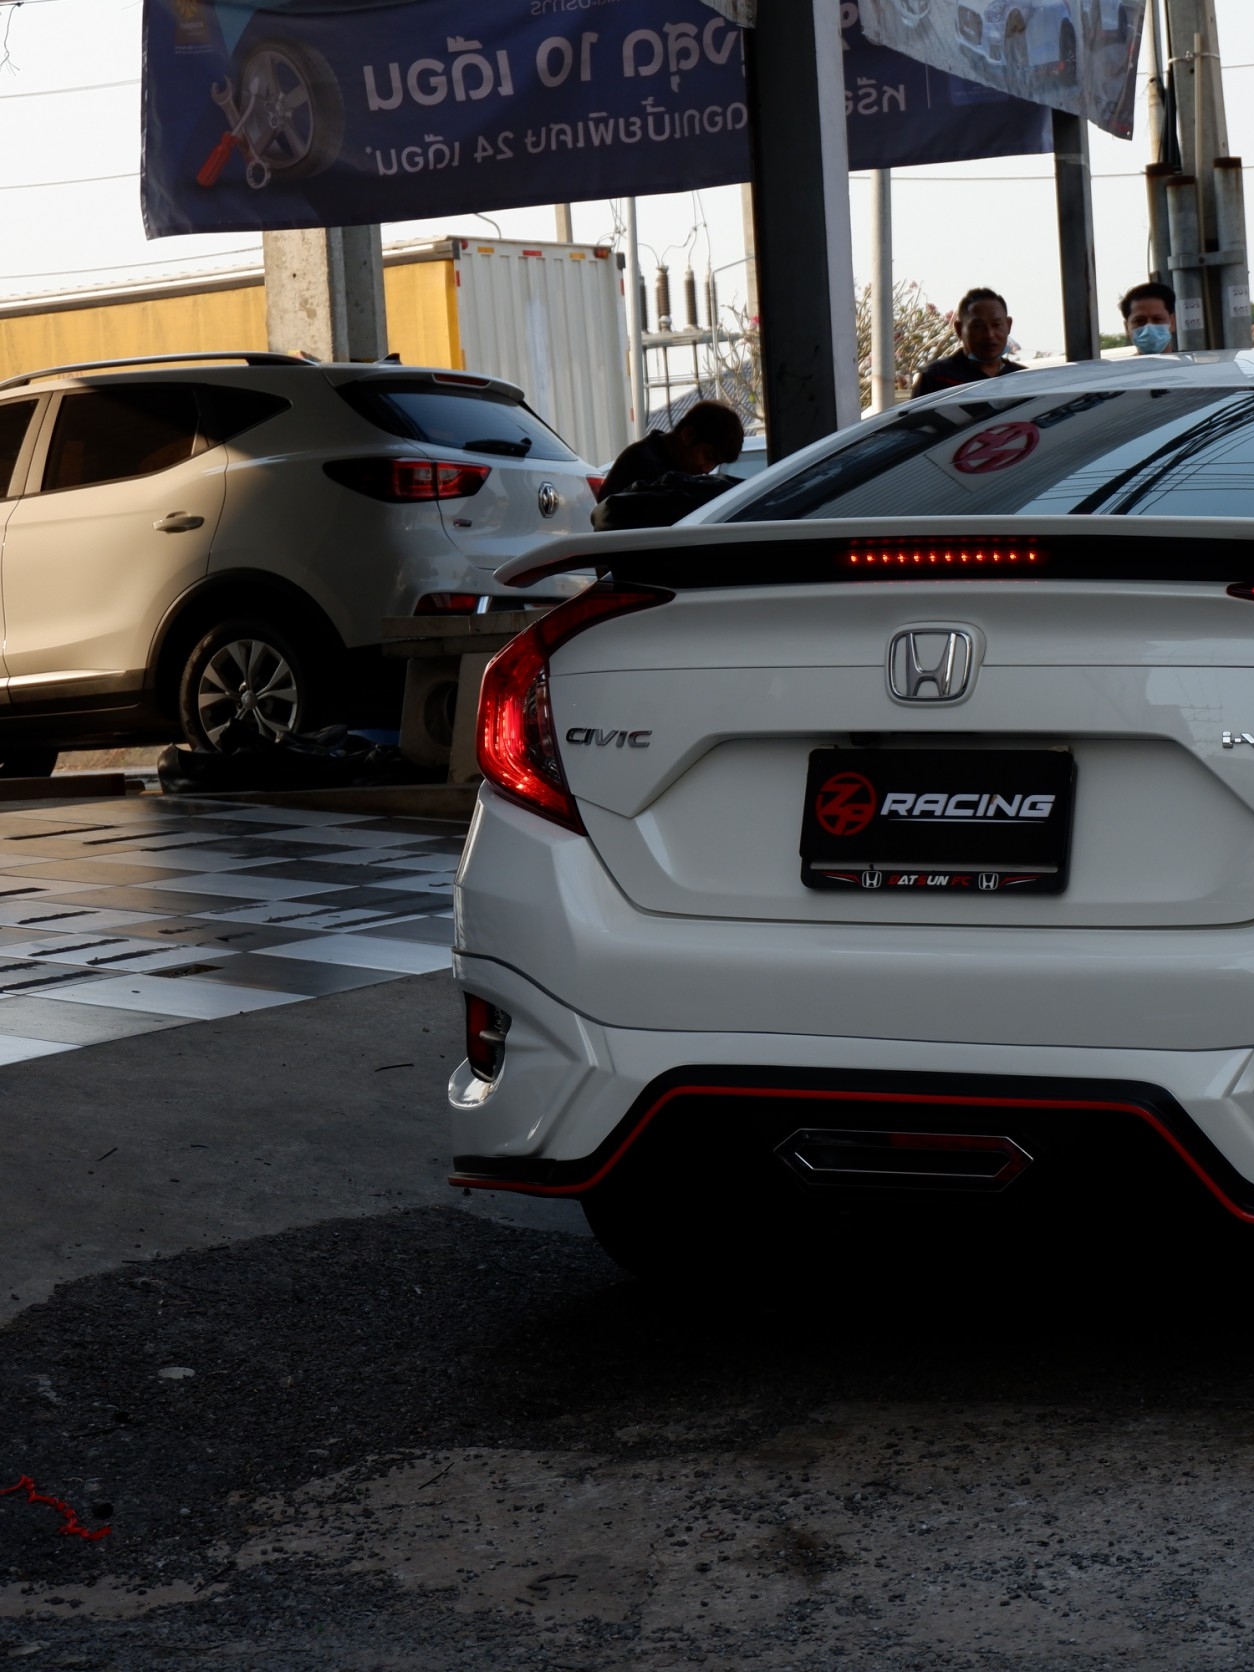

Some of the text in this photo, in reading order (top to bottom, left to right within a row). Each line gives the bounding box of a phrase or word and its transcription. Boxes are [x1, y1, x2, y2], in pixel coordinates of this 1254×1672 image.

[566, 727, 653, 748] CIVIC
[880, 792, 1056, 818] RACING
[887, 874, 950, 887] DATSUN
